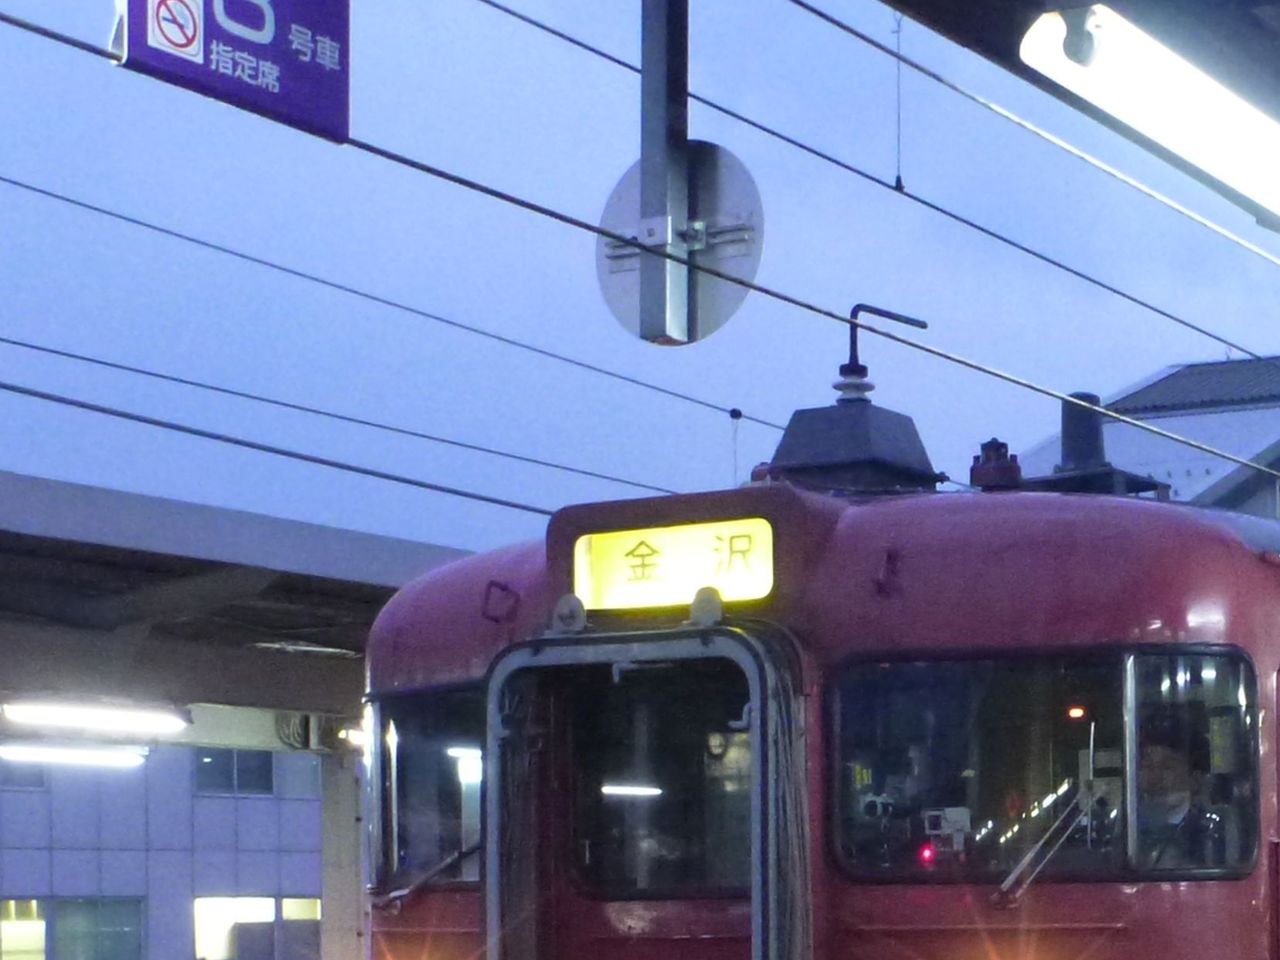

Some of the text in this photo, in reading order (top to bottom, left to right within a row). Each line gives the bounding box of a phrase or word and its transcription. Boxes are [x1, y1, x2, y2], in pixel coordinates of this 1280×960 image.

[209, 39, 280, 94] 指定席
[624, 534, 752, 582] 金沢
